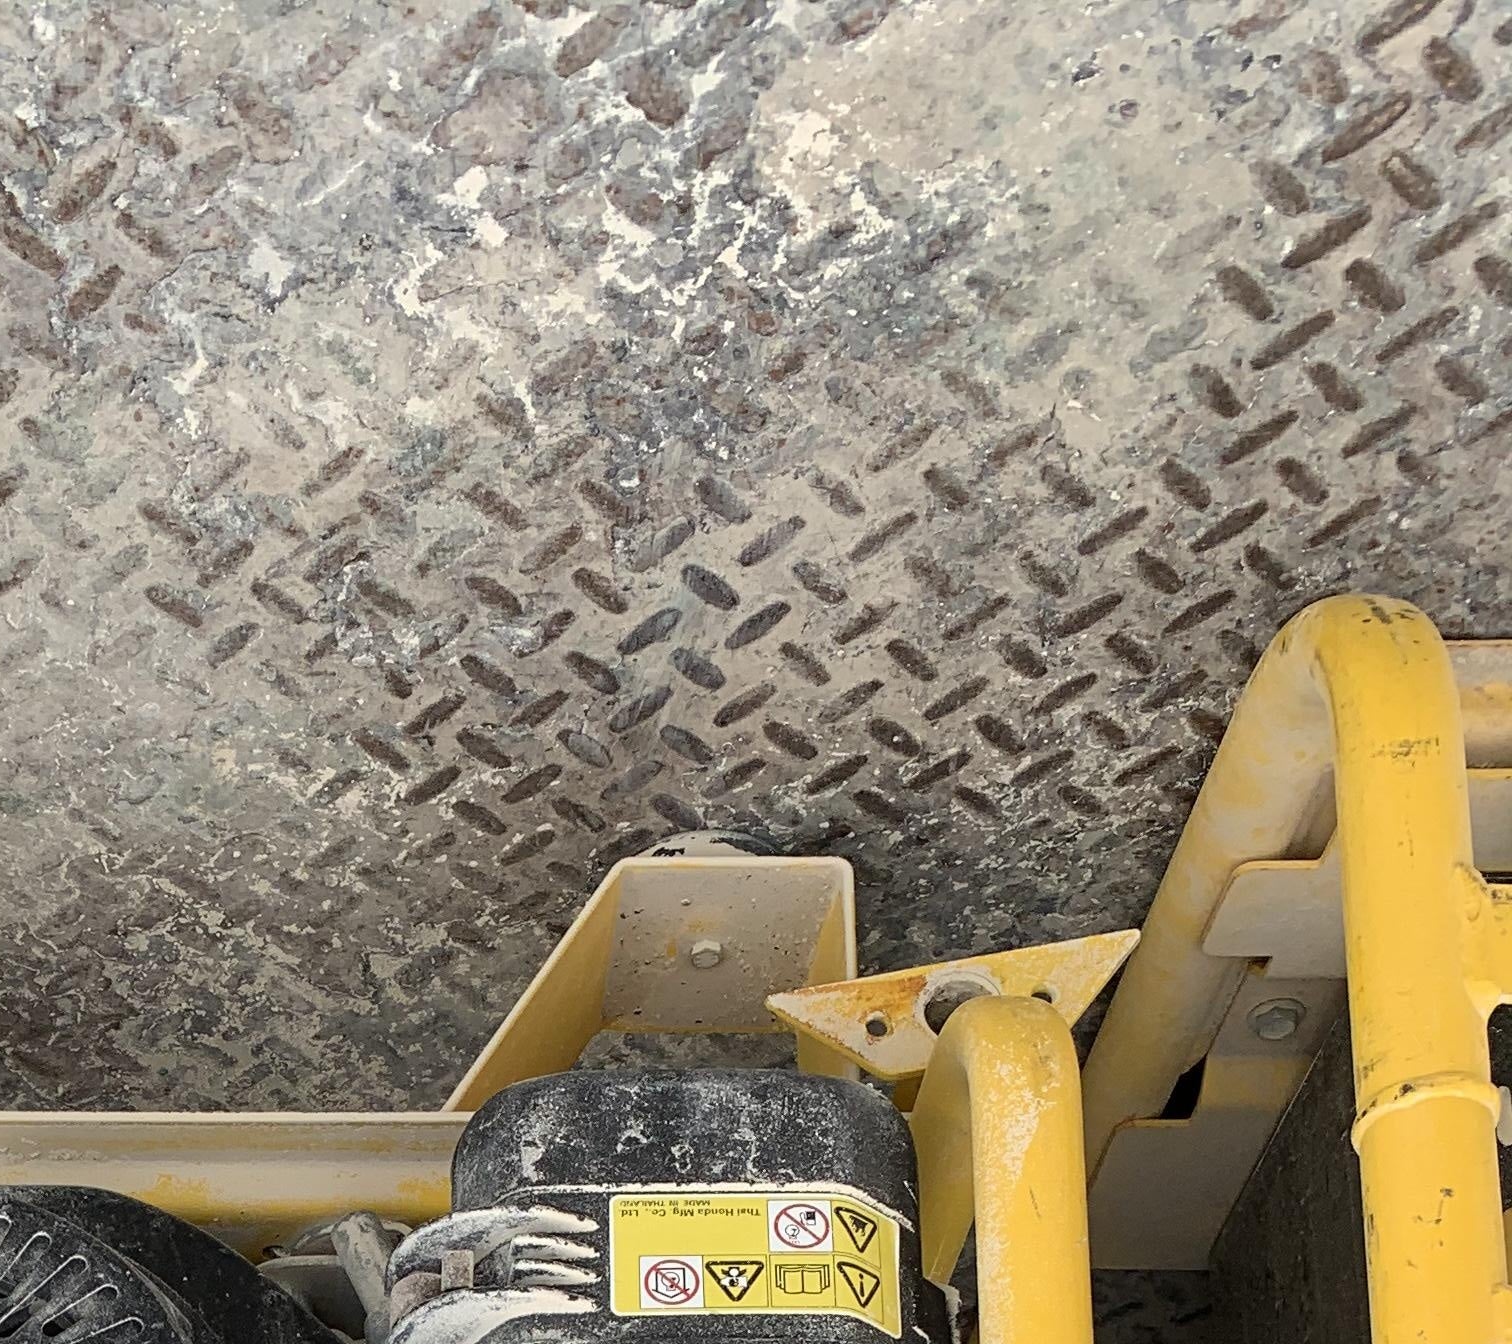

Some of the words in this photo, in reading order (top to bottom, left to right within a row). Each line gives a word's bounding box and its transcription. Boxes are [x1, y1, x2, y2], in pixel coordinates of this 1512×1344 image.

[684, 1199, 710, 1207] MADE
[697, 1208, 734, 1217] Honda
[737, 1208, 761, 1217] Thai
